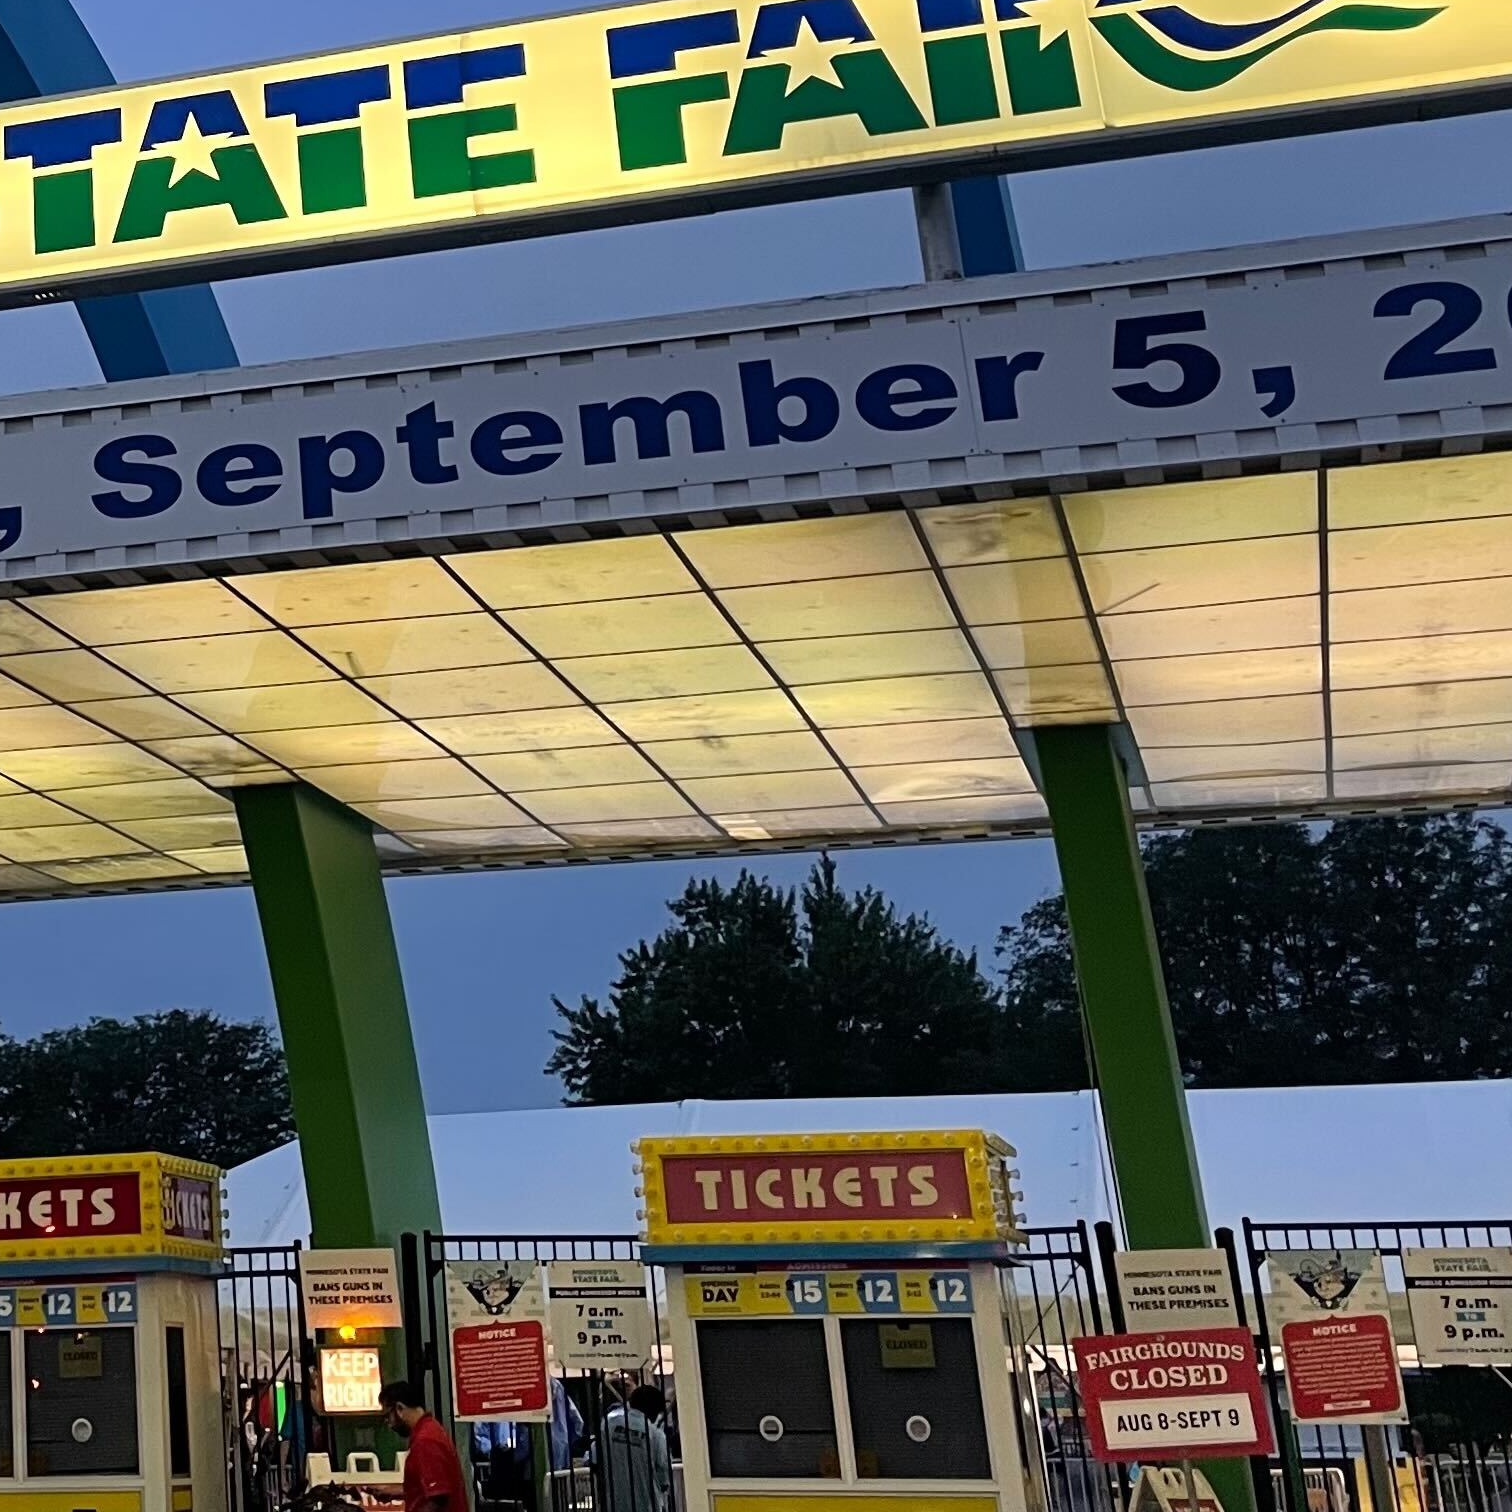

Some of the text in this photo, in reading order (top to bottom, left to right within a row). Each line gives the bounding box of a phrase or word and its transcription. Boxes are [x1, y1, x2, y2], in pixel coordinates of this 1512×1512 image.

[90, 351, 1044, 519] September
[1111, 310, 1295, 418] 5,
[1373, 281, 1512, 380] 2
[695, 1165, 938, 1210] TICKETS
[1124, 1270, 1172, 1278] MINNESOTA
[313, 1282, 383, 1292] BANS GUNS IN
[1133, 1285, 1216, 1296] BANS GUNS IN
[308, 1295, 392, 1304] THESE PREMISES
[702, 1288, 739, 1303] DAY
[1440, 1296, 1498, 1308] 7 a.m.
[576, 1304, 624, 1317] 7 a.m.
[1128, 1299, 1229, 1310] THESE PREMISES
[478, 1328, 516, 1340] NOTICE
[1313, 1324, 1357, 1336] NOTICE
[1445, 1325, 1504, 1341] 9 p.m.
[577, 1332, 627, 1347] 9 p.m.
[886, 1340, 928, 1350] CLOSED
[1085, 1342, 1245, 1370] FAIRGROUNDS
[324, 1352, 378, 1377] KEEP
[1110, 1364, 1228, 1390] CLOSED
[325, 1384, 381, 1407] RIGHT
[1117, 1409, 1240, 1432] AUG 8-SEPT 9
